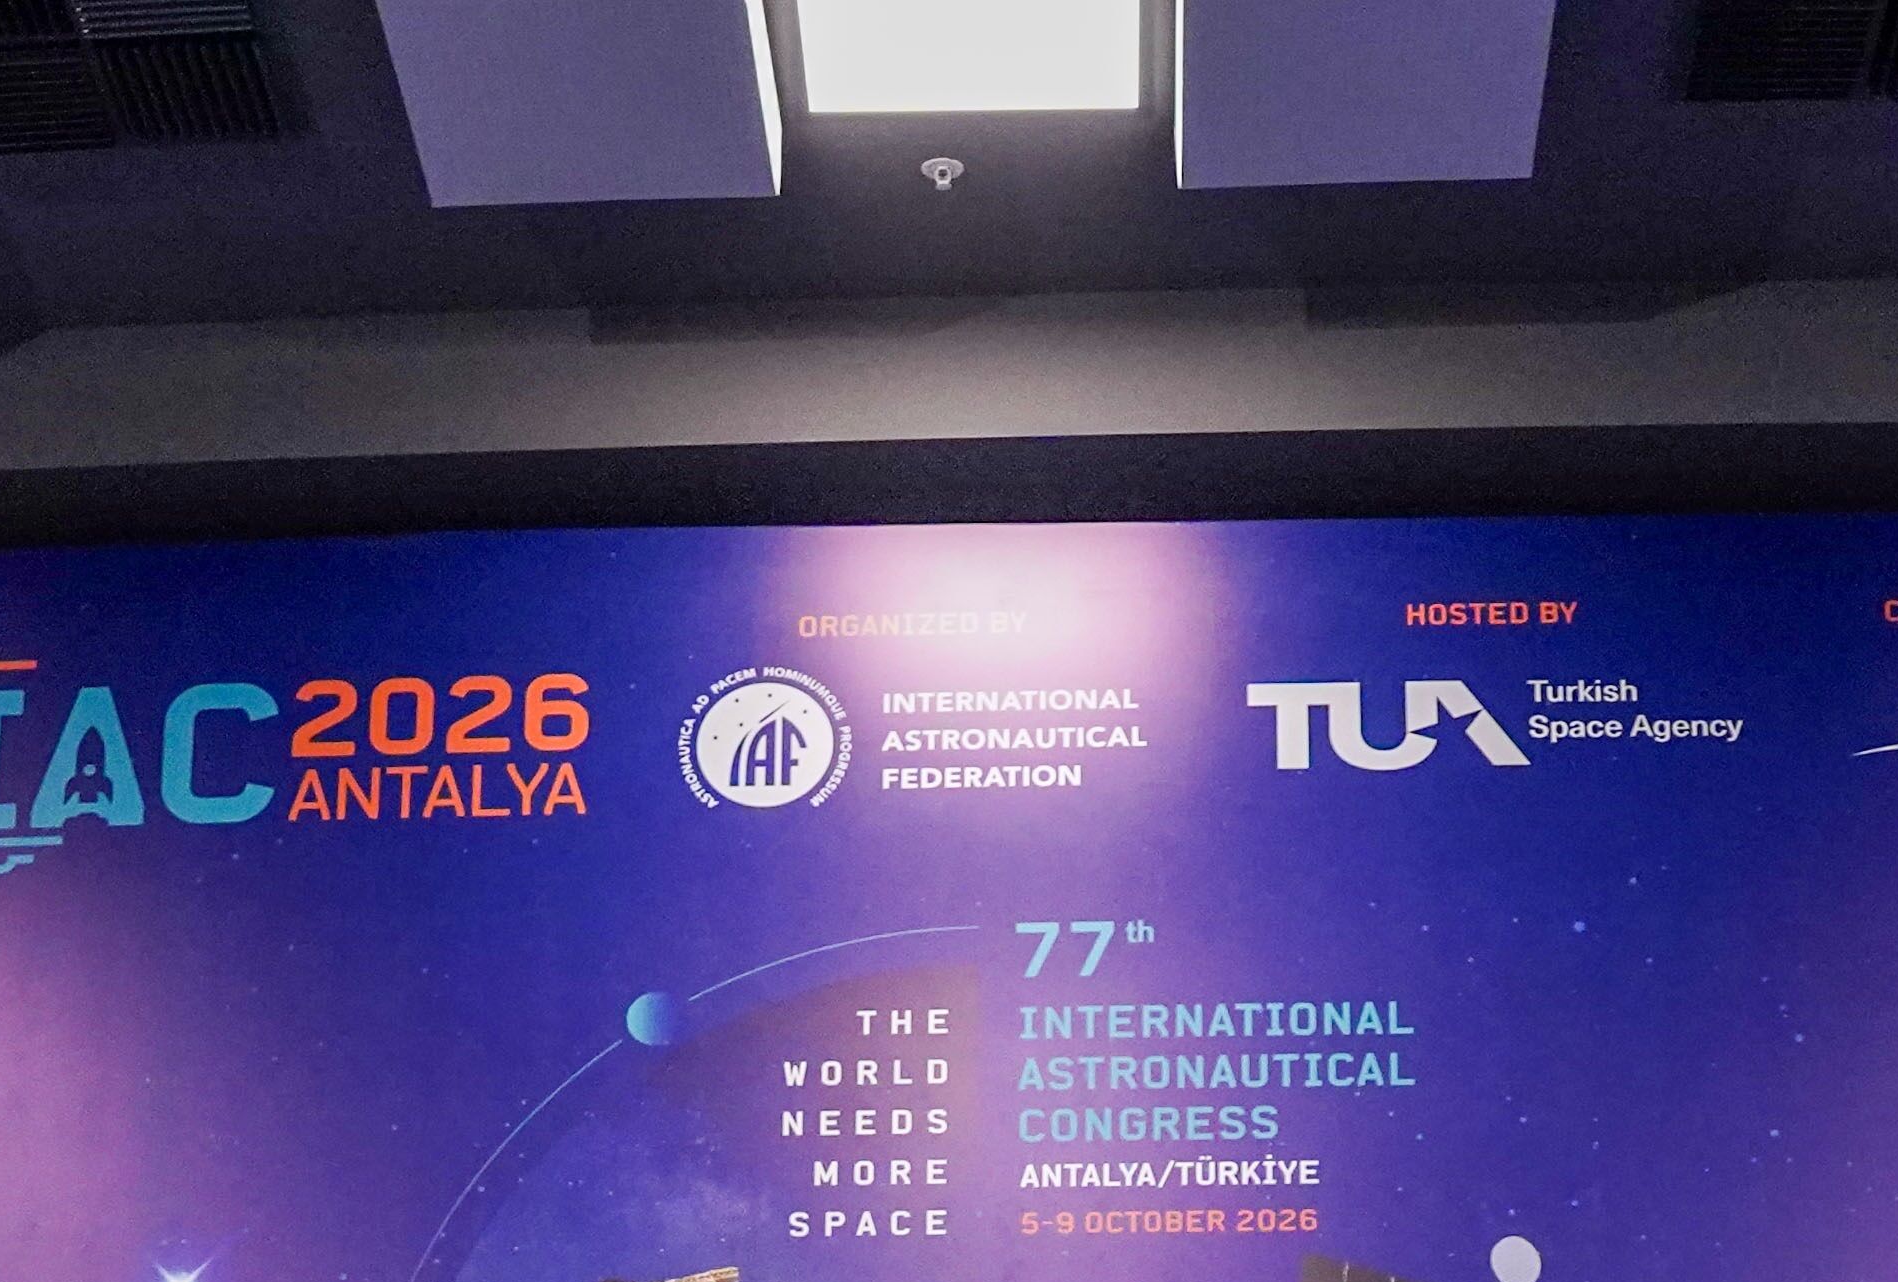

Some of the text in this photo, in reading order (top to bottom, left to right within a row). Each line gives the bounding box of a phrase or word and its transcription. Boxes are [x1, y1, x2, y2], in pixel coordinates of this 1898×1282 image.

[799, 611, 1027, 638] ORGANIZED BY
[1406, 601, 1578, 626] HOSTED BY
[882, 688, 1139, 714] INTERNATIONAL
[1526, 679, 1638, 702] Turkish
[292, 673, 590, 758] 2026
[1247, 680, 1531, 771] TUA
[1529, 715, 1743, 743] Space Agency
[678, 667, 853, 809] ASTRONAUTICA AD PACEM HOMINUMQUE PROGRESSUM
[882, 725, 1147, 752] ASTRONAUTICAL
[882, 765, 1082, 790] FEDERATION
[289, 762, 587, 822] ANTALYA
[1015, 920, 1155, 978] 77th
[857, 1009, 950, 1036] THE
[1020, 1001, 1415, 1040] INTERNATIONAL
[784, 1059, 949, 1087] WORLD
[1018, 1052, 1415, 1091] ASTRONAUTICAL
[782, 1109, 949, 1136] NEEDS
[1019, 1104, 1278, 1143] CONGRESS
[814, 1159, 948, 1186] MORE
[1020, 1154, 1320, 1189] ANTALYA/TÜRKİYE
[789, 1210, 947, 1238] SPACE
[1021, 1209, 1318, 1235] 5-9 OCTOBER 2026
